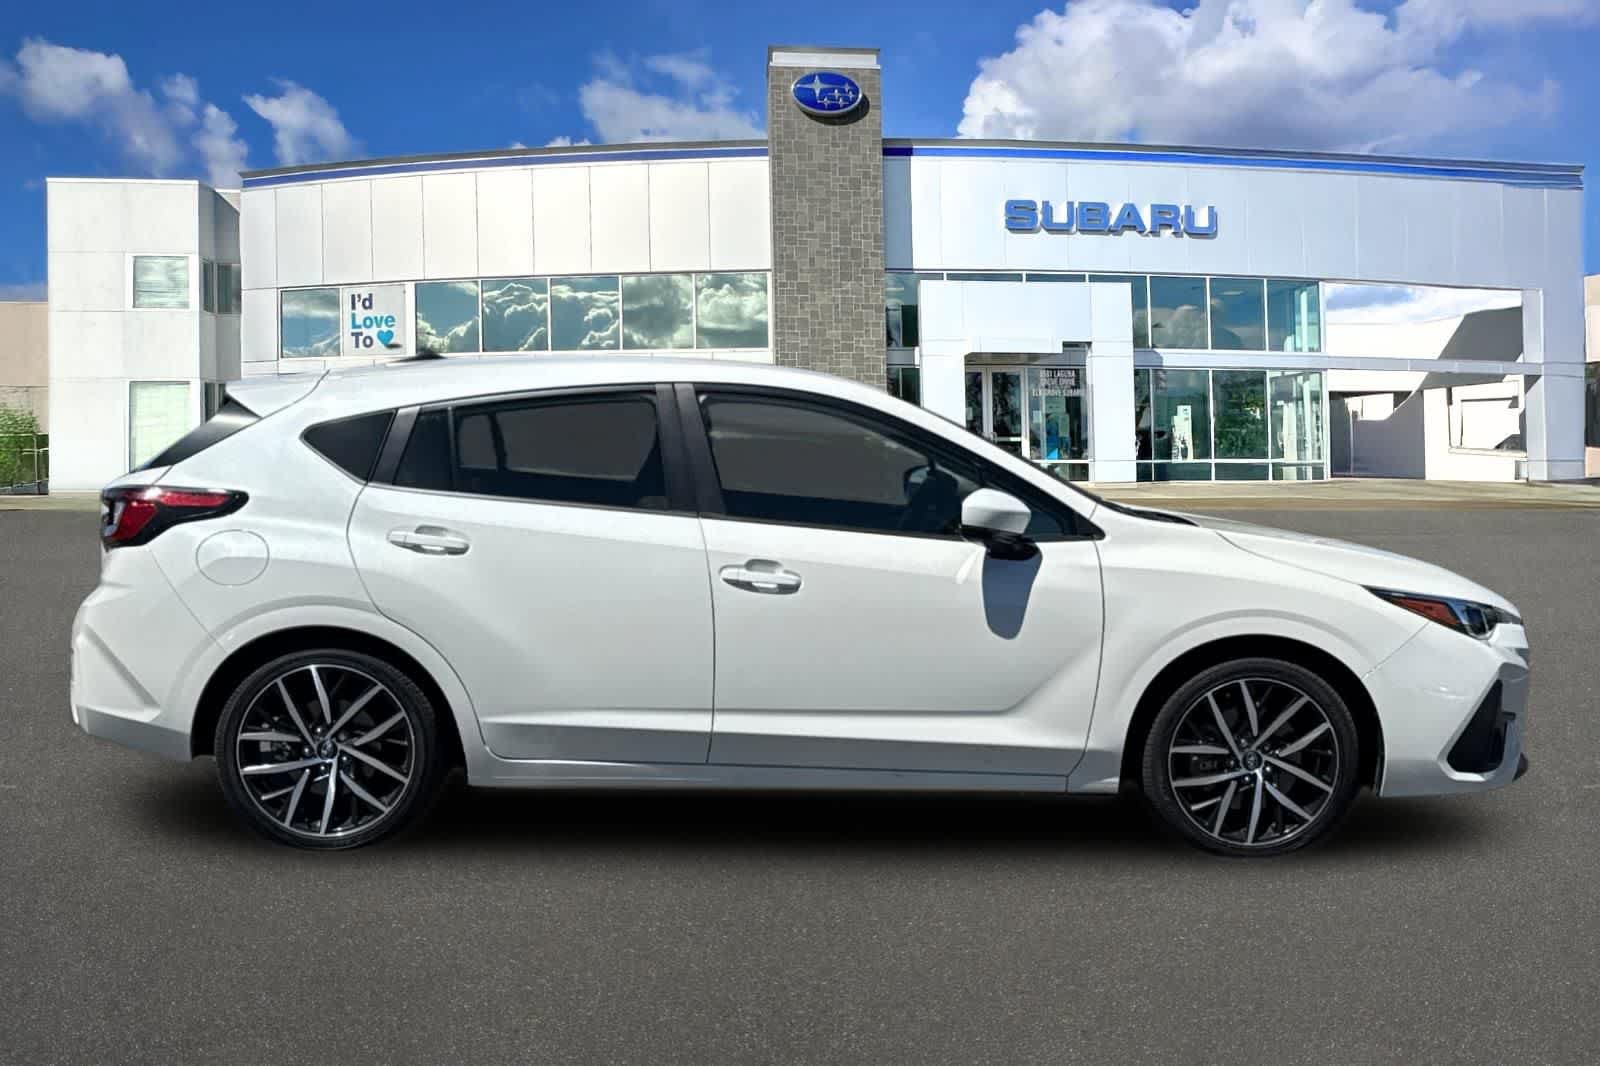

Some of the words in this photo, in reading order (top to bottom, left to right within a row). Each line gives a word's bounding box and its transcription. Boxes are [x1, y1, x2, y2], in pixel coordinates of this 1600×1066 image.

[1005, 199, 1218, 239] SUBARU
[351, 293, 373, 311] I'd
[351, 312, 396, 329] Love
[351, 331, 374, 349] To
